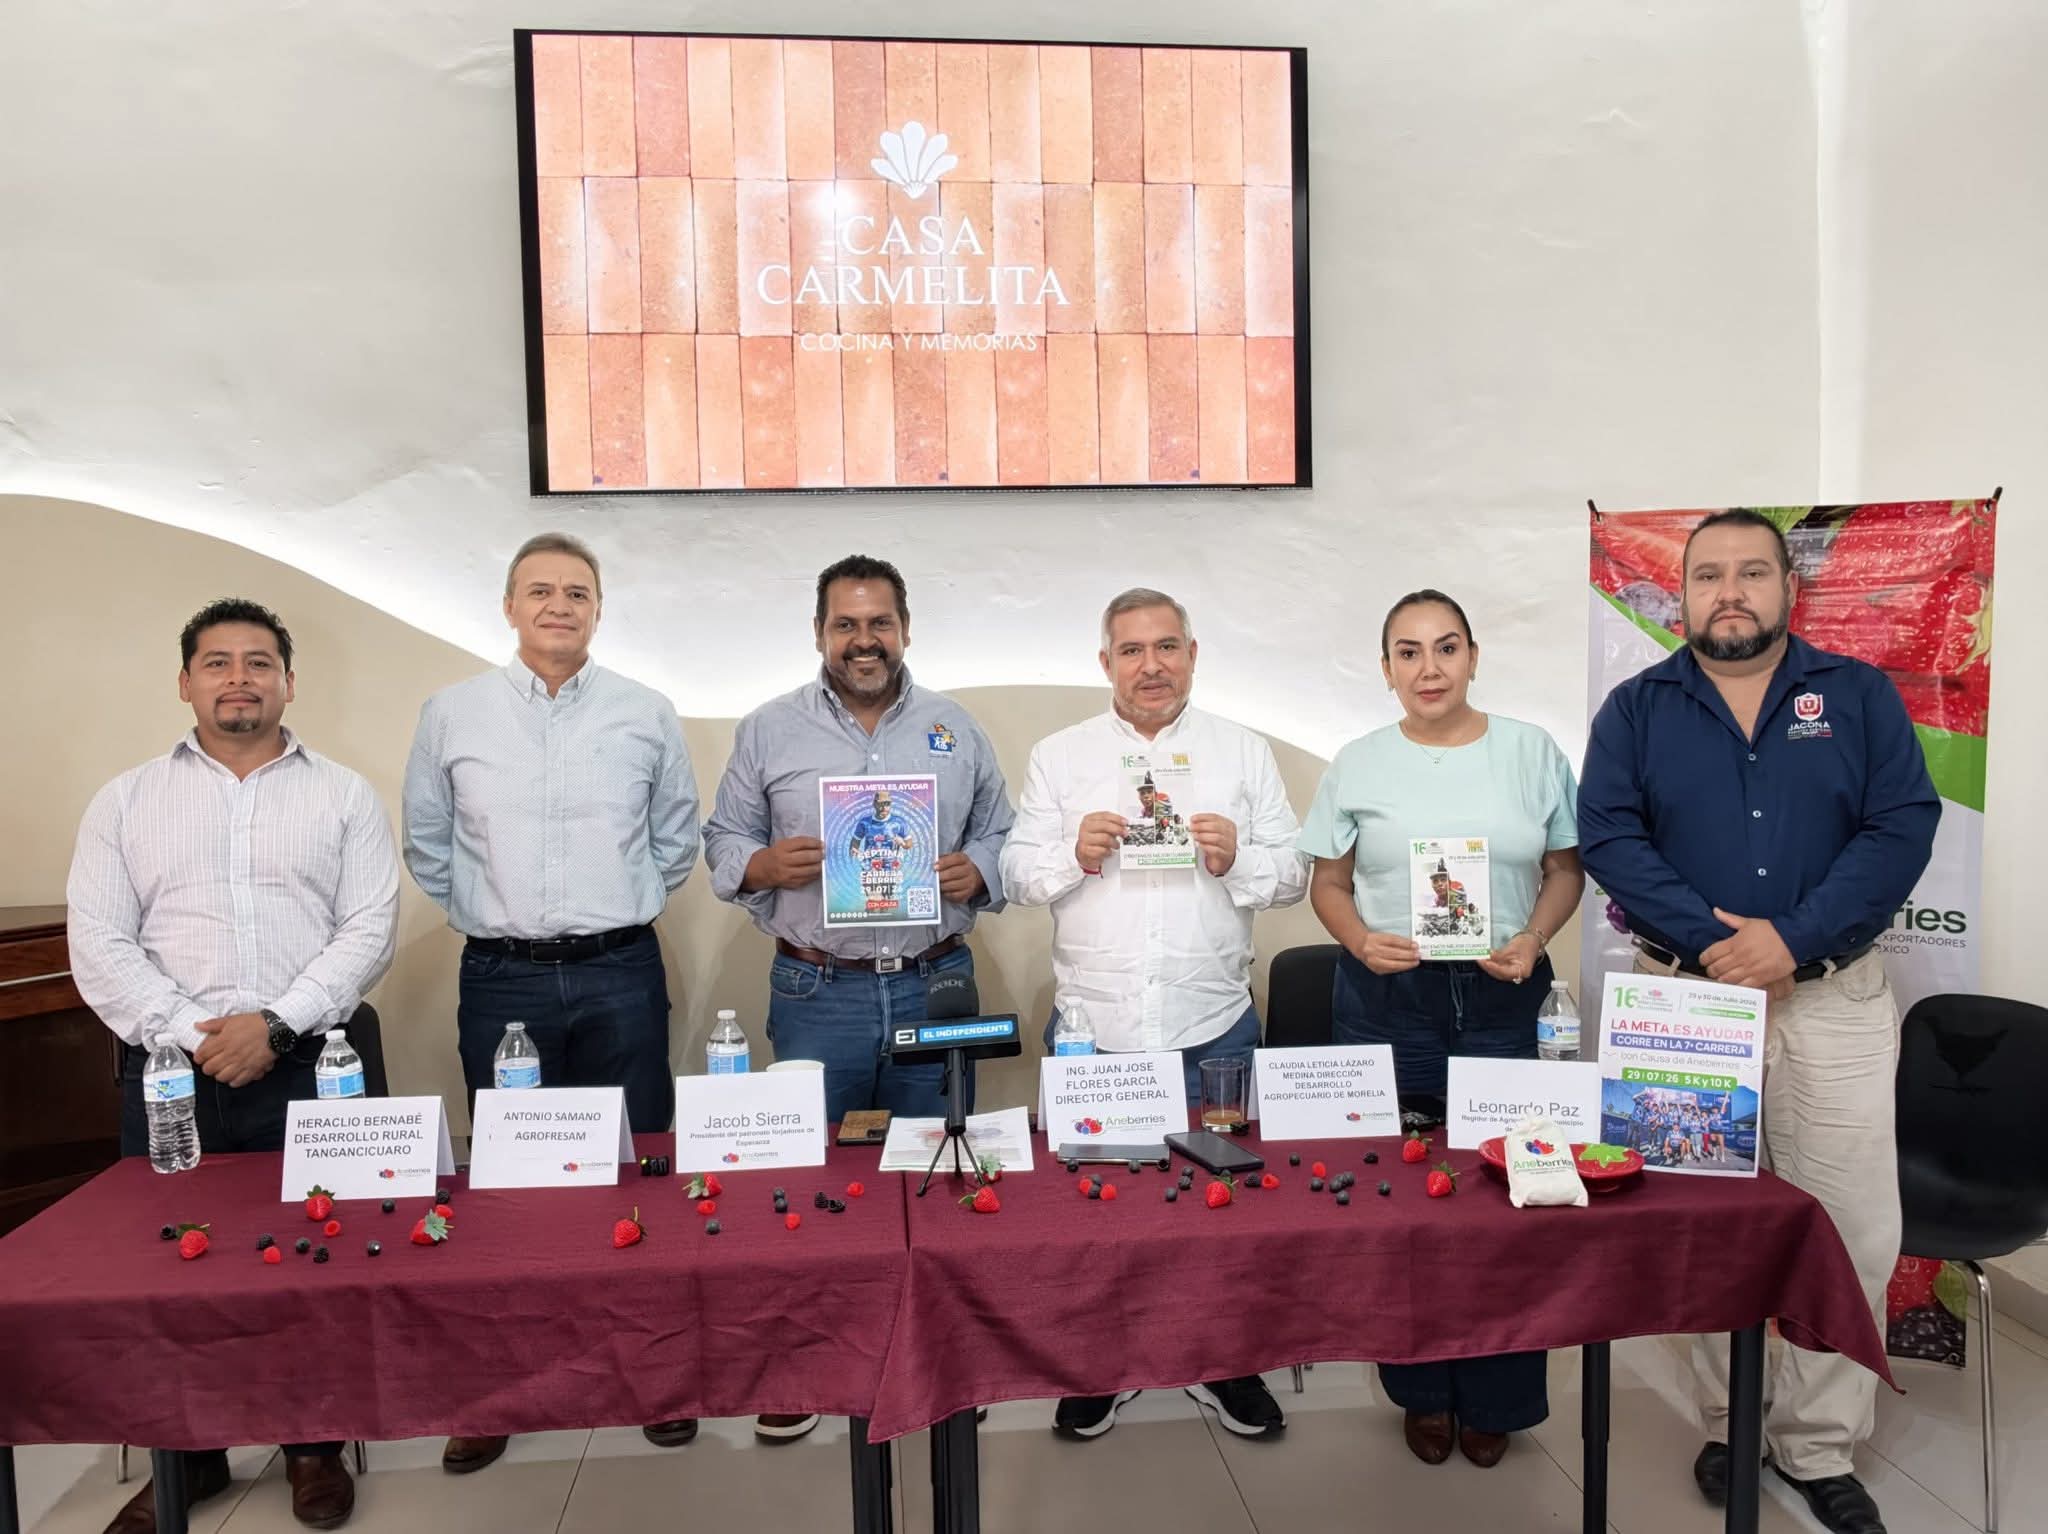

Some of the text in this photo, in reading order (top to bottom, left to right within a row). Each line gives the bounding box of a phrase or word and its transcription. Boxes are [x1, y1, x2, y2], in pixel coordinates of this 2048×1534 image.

[841, 216, 984, 255] CASA
[757, 265, 1070, 305] CARMELITA
[800, 333, 1037, 351] COCINA Y MEMORIAS
[1788, 721, 1830, 730] JACONA
[898, 783, 929, 791] AYUDAR
[1882, 934, 1967, 948] XPORTADORES
[1615, 986, 1638, 1008] 16
[923, 1024, 1009, 1039] EL INDEPENDIENTE
[1611, 1019, 1754, 1041] LA META ES AYUDAR
[1616, 1035, 1651, 1048] CORRE
[1654, 1039, 1668, 1049] EN
[1670, 1040, 1682, 1050] LA
[1695, 1042, 1745, 1055] CARRERA
[1269, 1061, 1305, 1070] CLAUDIA
[1307, 1060, 1338, 1069] LETICIA
[1640, 1052, 1670, 1064] Causa
[1673, 1054, 1685, 1064] de
[1687, 1057, 1740, 1070] Aneberries
[1066, 1062, 1154, 1076] ING. JUAN JOSE
[1283, 1071, 1315, 1080] MEDINA
[1066, 1076, 1157, 1090] FLORES GARCIA
[1627, 1070, 1640, 1079] 29
[1647, 1072, 1659, 1081] 07
[1665, 1073, 1679, 1083] 26
[1295, 1081, 1352, 1089] DESARROLLO
[1056, 1089, 1169, 1105] DIRECTOR GENERAL
[1264, 1091, 1331, 1100] AGROPECUARIO
[1347, 1090, 1385, 1098] MORELIA
[504, 1111, 601, 1121] ANTONIO SAMANO
[1550, 1102, 1579, 1117] Paz
[297, 1112, 422, 1129] HERACLIO BERNABÉ
[704, 1112, 801, 1129] Jacob Sierra
[1106, 1113, 1166, 1126] Aneberries
[295, 1130, 423, 1144] DESARROLLO RURAL
[515, 1131, 586, 1141] AGROFRESAM
[739, 1130, 770, 1138] patronato
[305, 1145, 411, 1158] TANGANCICUARO
